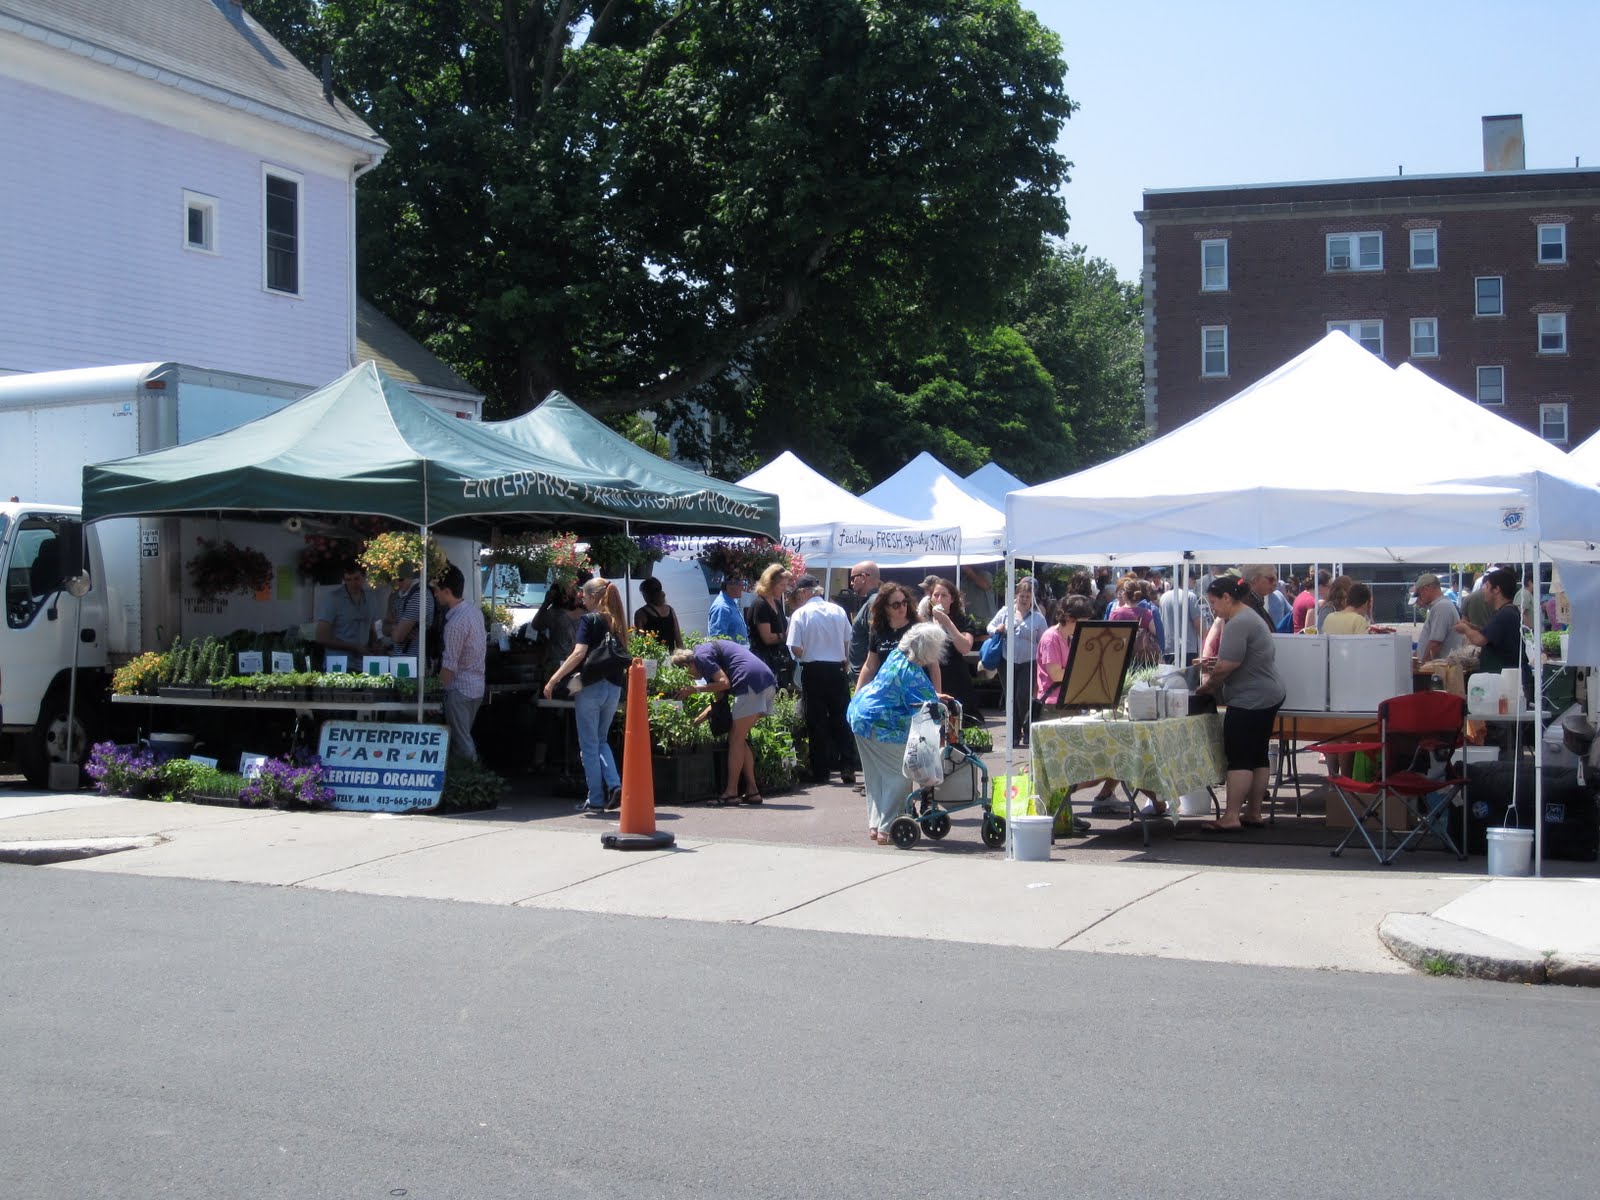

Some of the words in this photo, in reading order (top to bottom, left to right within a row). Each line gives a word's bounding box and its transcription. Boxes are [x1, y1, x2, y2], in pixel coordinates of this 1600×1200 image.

[463, 470, 579, 500] ENTERPRISE
[698, 489, 764, 520] PRODUCE
[876, 531, 903, 550] FRESH
[930, 533, 957, 551] STINKY
[329, 728, 441, 745] ENTERPRISE
[323, 770, 378, 785] CERTIFIED
[383, 773, 435, 787] ORGANIC
[357, 795, 370, 804] MA
[376, 796, 432, 807] 413-665-8608
